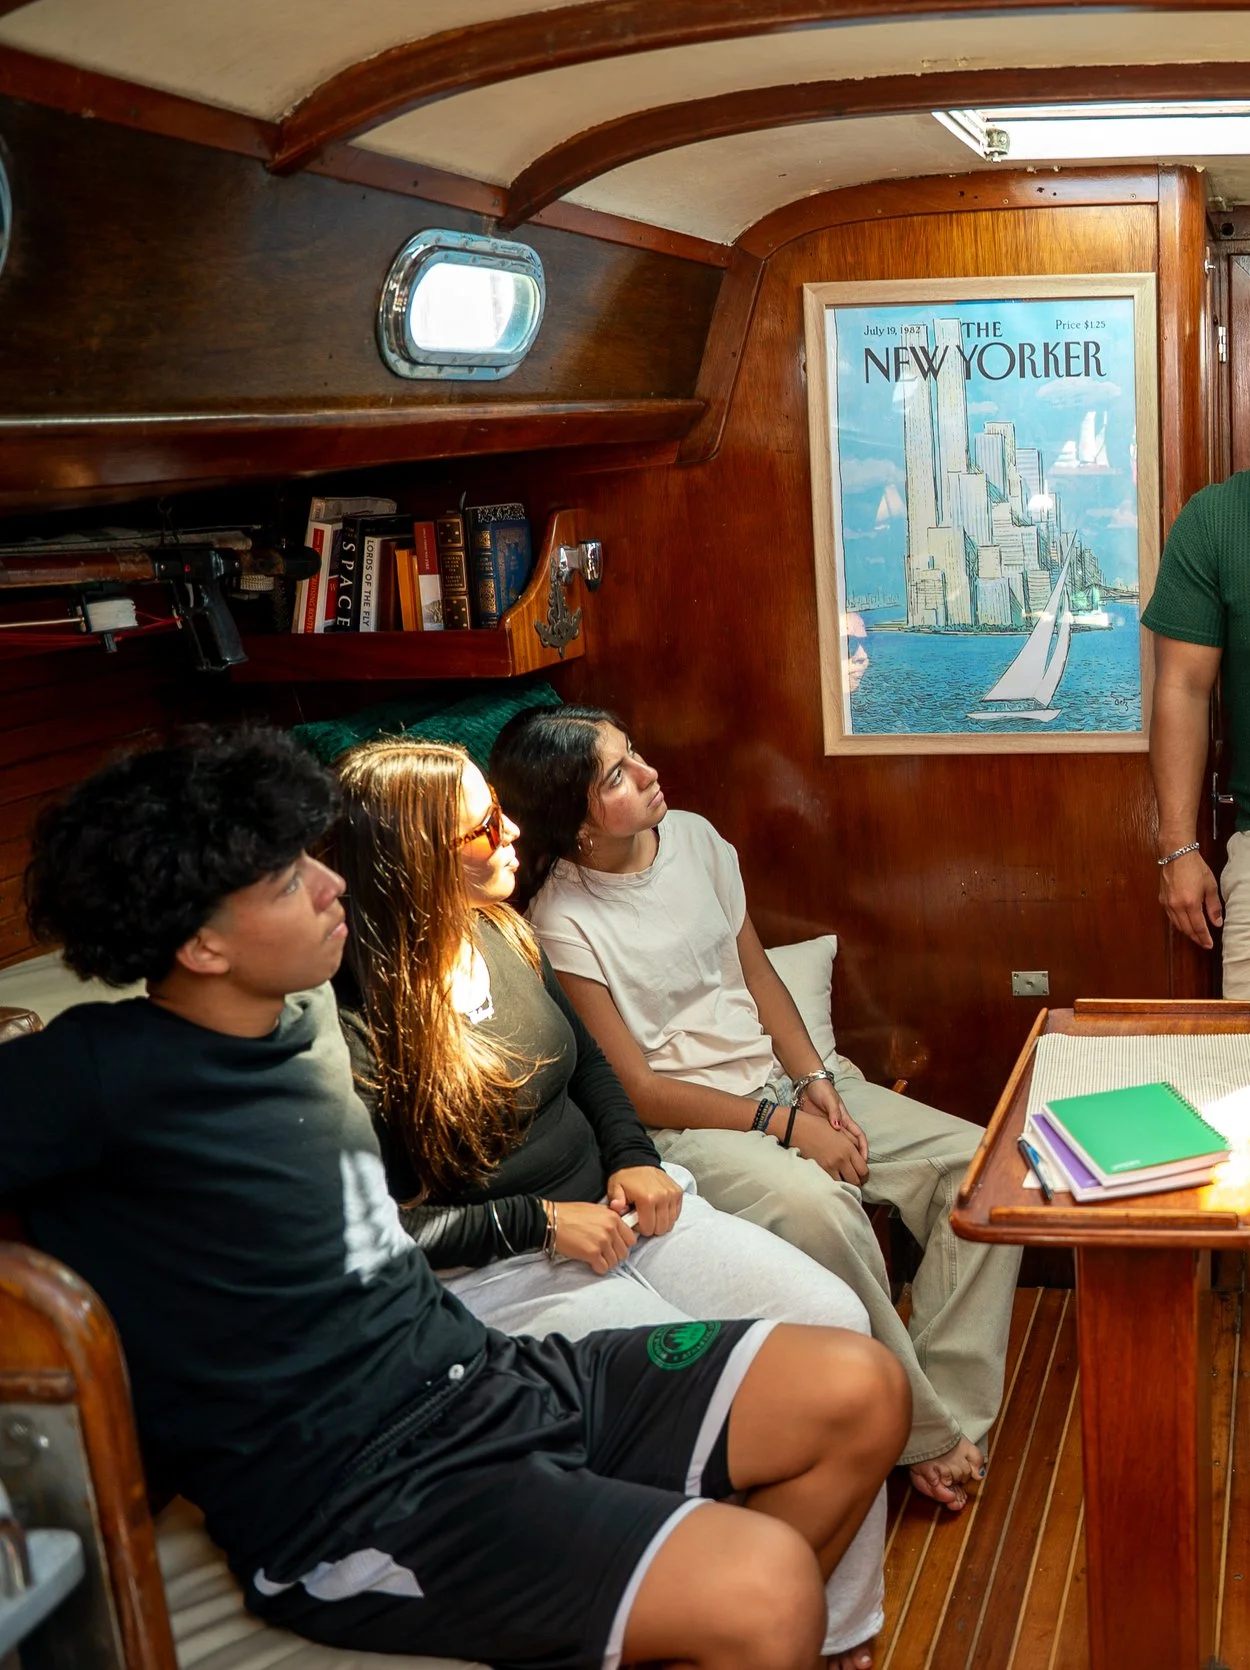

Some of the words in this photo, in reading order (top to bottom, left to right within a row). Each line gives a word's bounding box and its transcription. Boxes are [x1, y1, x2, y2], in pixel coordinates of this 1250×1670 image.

[863, 325, 885, 337] July
[887, 326, 898, 336] 19,
[900, 325, 921, 335] 1982
[961, 320, 1003, 339] THE
[1055, 319, 1082, 330] Price
[864, 344, 949, 384] NEW
[955, 340, 1107, 381] YORKER
[365, 540, 374, 571] LORDS
[336, 541, 356, 627] SPACE
[364, 575, 373, 588] OF
[362, 591, 372, 608] THE
[361, 611, 371, 627] FLY
